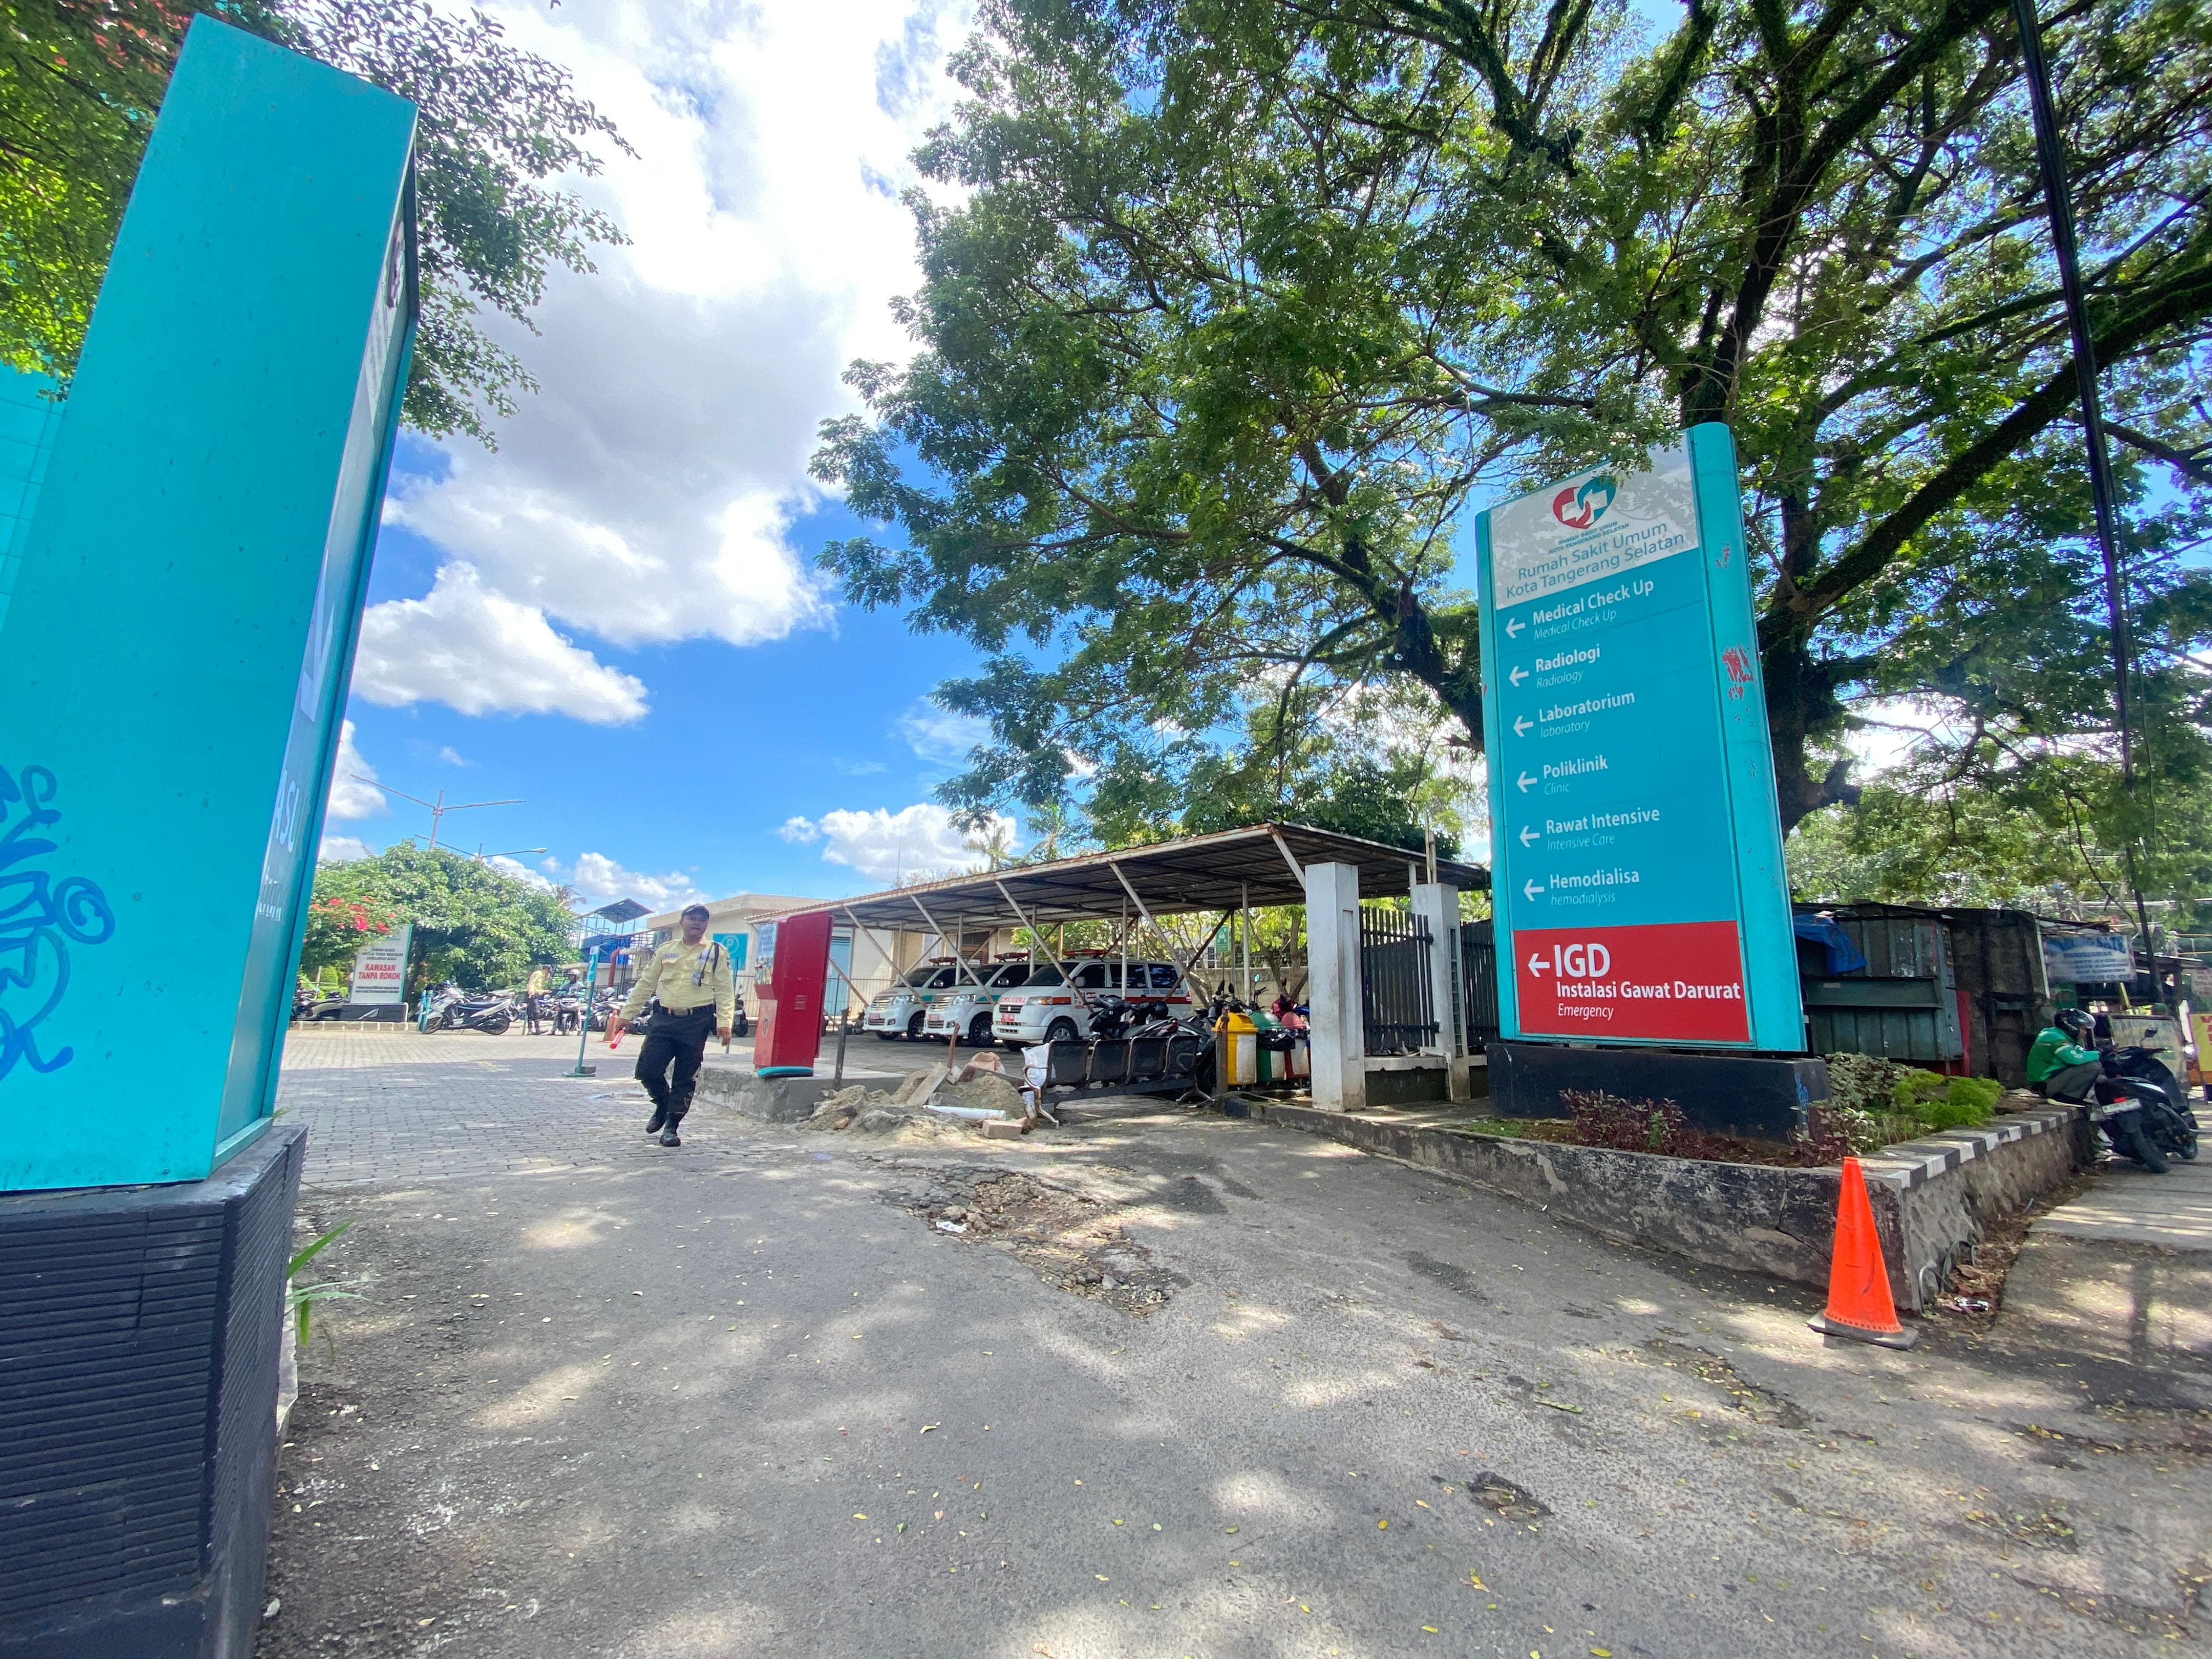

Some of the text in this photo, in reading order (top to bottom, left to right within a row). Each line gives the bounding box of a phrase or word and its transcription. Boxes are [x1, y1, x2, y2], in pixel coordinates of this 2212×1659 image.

[1559, 534, 1579, 545] RUMAH
[1599, 521, 1618, 531] UMUM
[1565, 533, 1601, 548] TANGERANG
[1602, 523, 1629, 535] SELATAN
[1519, 523, 1667, 579] Rumah Sakit Umum
[1506, 533, 1684, 599] Kota Tangerang Selatan
[1533, 579, 1654, 625] Medical Check Up
[1534, 609, 1617, 640] Medical Check Up
[1536, 644, 1600, 673] Radiologi
[1537, 670, 1583, 689] Radiology
[1539, 692, 1635, 723] Laboratorium
[1541, 720, 1590, 737] laboratory
[1543, 754, 1608, 779] Poliklinik
[1544, 782, 1570, 794] Clinic
[1547, 808, 1660, 834] Rawat Intensive
[1548, 833, 1615, 850] Intensive Care
[1550, 868, 1639, 889] Hemodialisa
[1551, 890, 1615, 906] hemodialysis
[1554, 943, 1611, 978] IGD
[1556, 980, 1741, 999] Instalasi Gawat Darurat
[1558, 1003, 1614, 1021] Emergency
